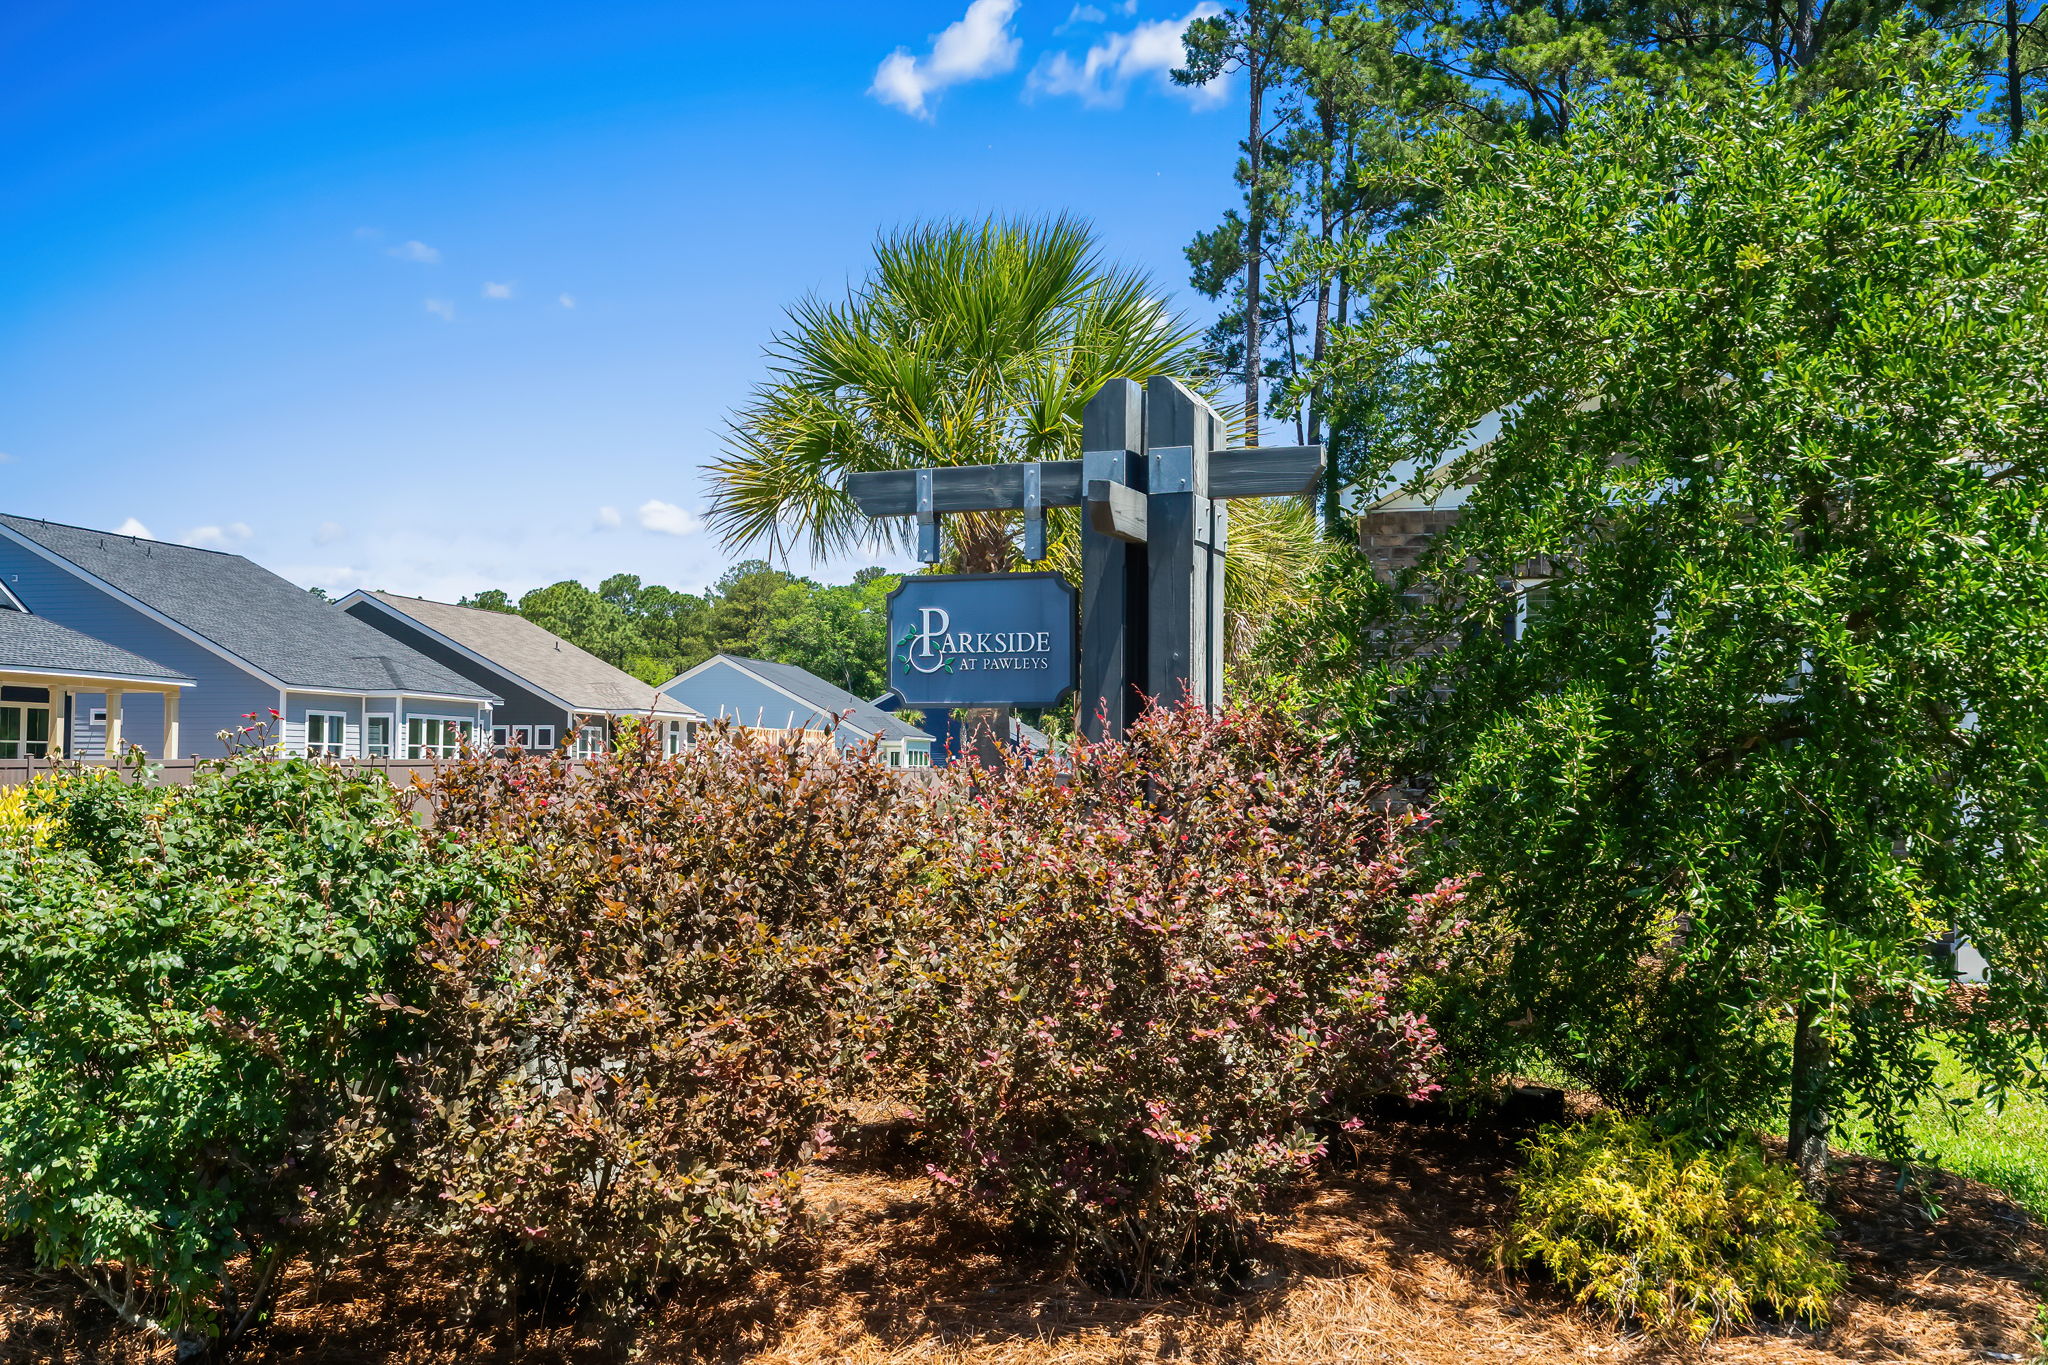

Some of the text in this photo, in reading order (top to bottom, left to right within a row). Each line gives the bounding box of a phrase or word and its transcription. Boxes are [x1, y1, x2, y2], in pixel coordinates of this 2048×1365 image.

[918, 608, 1051, 657] PARKSIDE
[959, 657, 1049, 671] AT PAWLEYS
